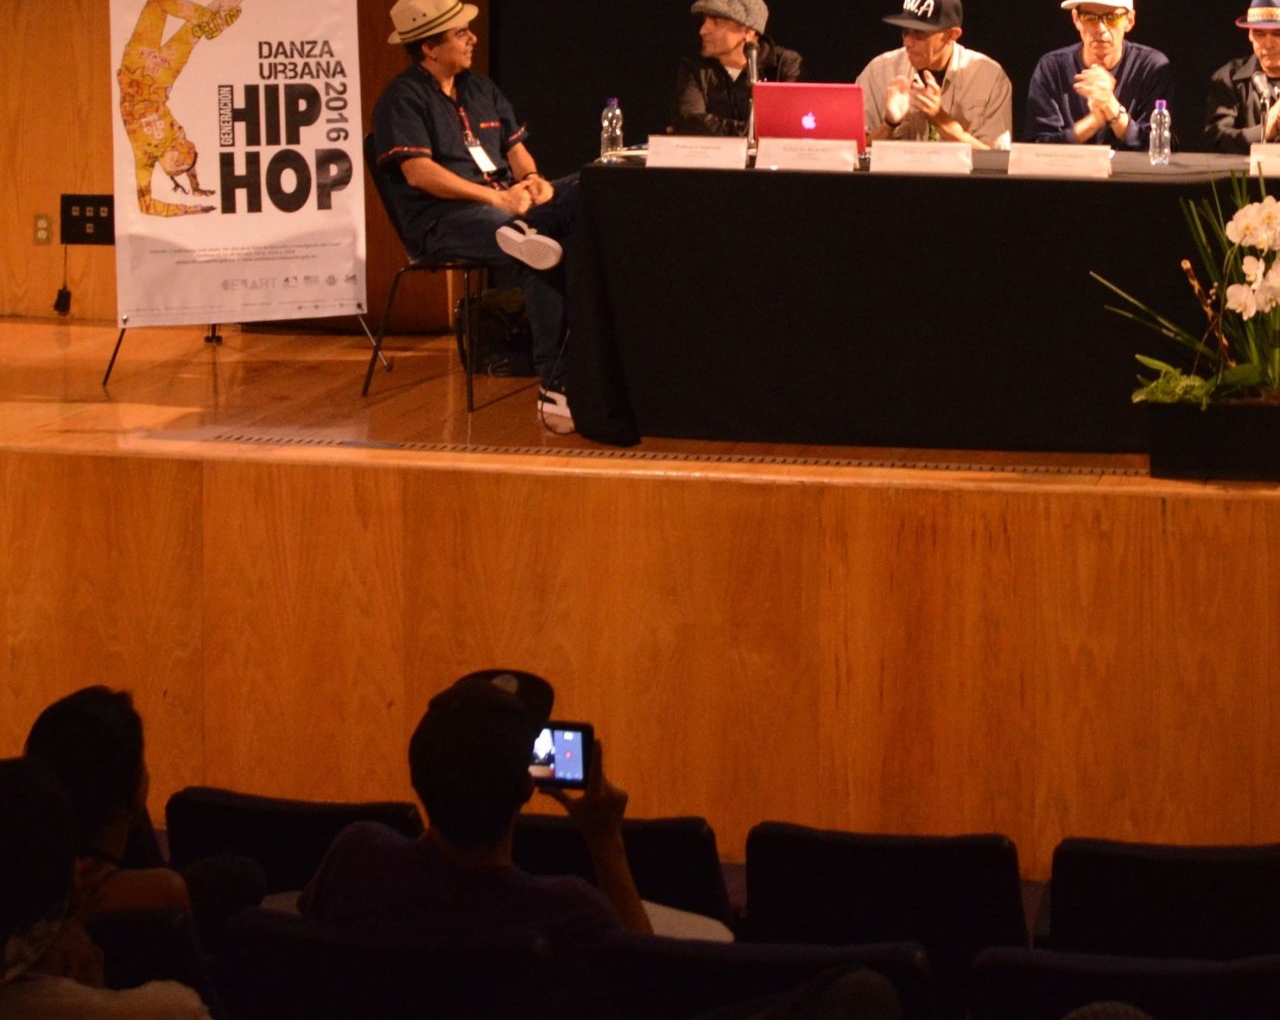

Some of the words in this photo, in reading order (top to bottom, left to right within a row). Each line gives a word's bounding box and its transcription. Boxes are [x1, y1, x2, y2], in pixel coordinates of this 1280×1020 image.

[258, 40, 334, 59] DANZA
[259, 61, 347, 80] URBANA
[218, 83, 322, 147] HIP
[325, 82, 349, 142] 2016
[219, 148, 353, 214] HOP
